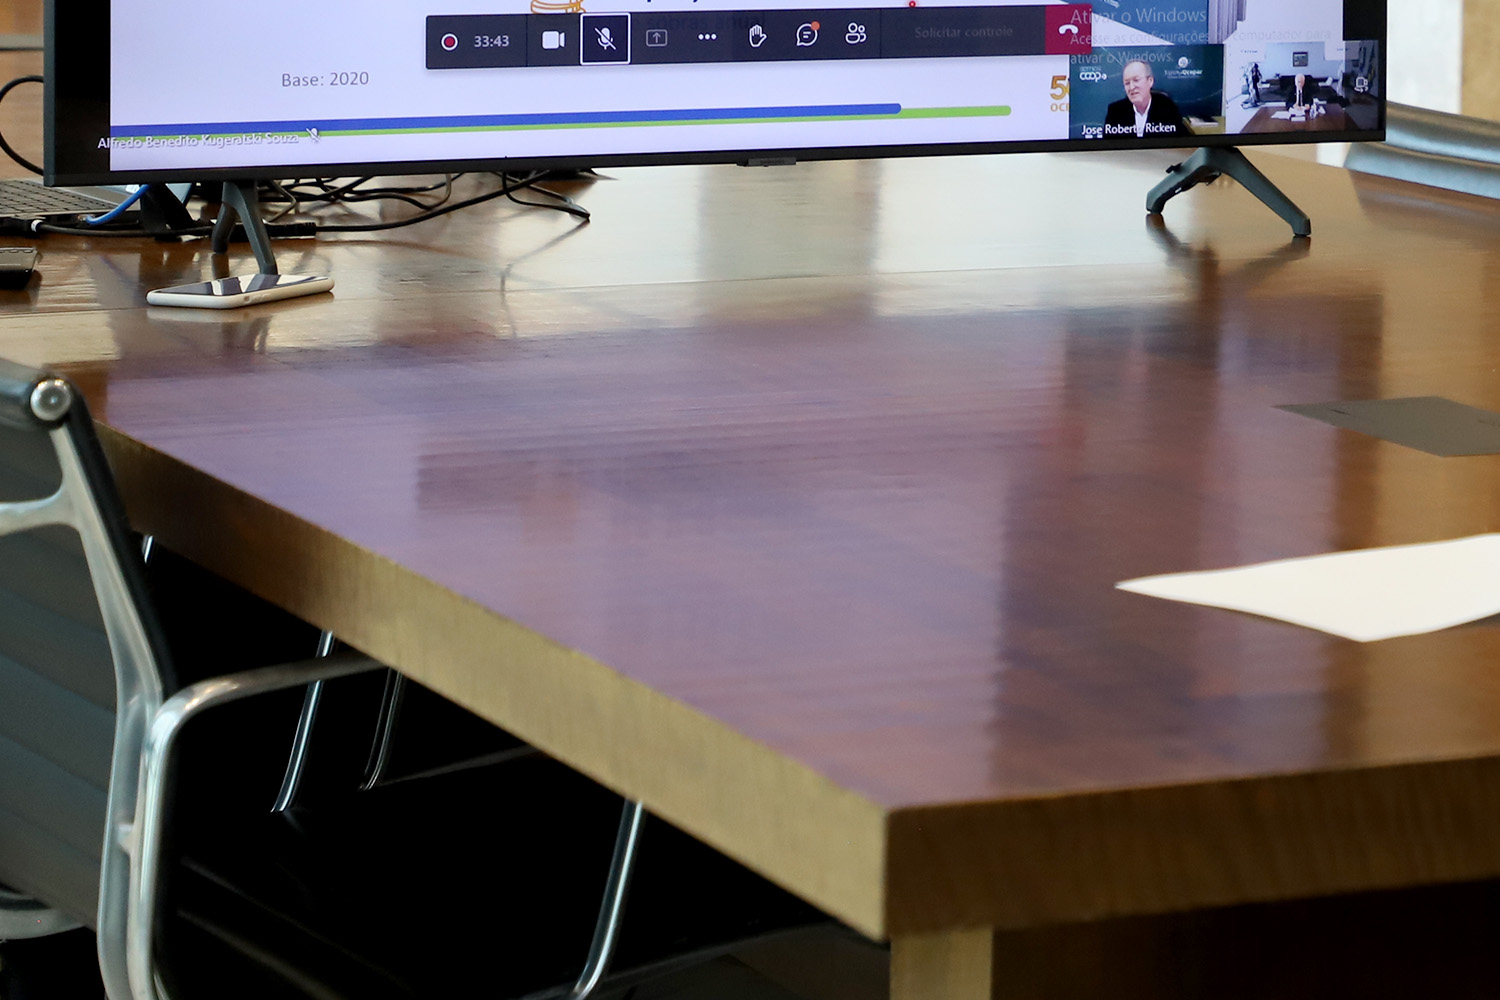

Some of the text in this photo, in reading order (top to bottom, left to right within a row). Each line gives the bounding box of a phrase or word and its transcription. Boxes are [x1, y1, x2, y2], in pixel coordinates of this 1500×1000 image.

[1070, 7, 1207, 25] Ativar o Windows
[473, 34, 510, 48] 33:43
[1070, 53, 1103, 65] ativar
[280, 70, 370, 88] Base: 2020
[1145, 122, 1177, 133] Ricken
[97, 137, 143, 150] Alfredo
[145, 136, 199, 148] Benedito
[265, 132, 300, 144] Souza
